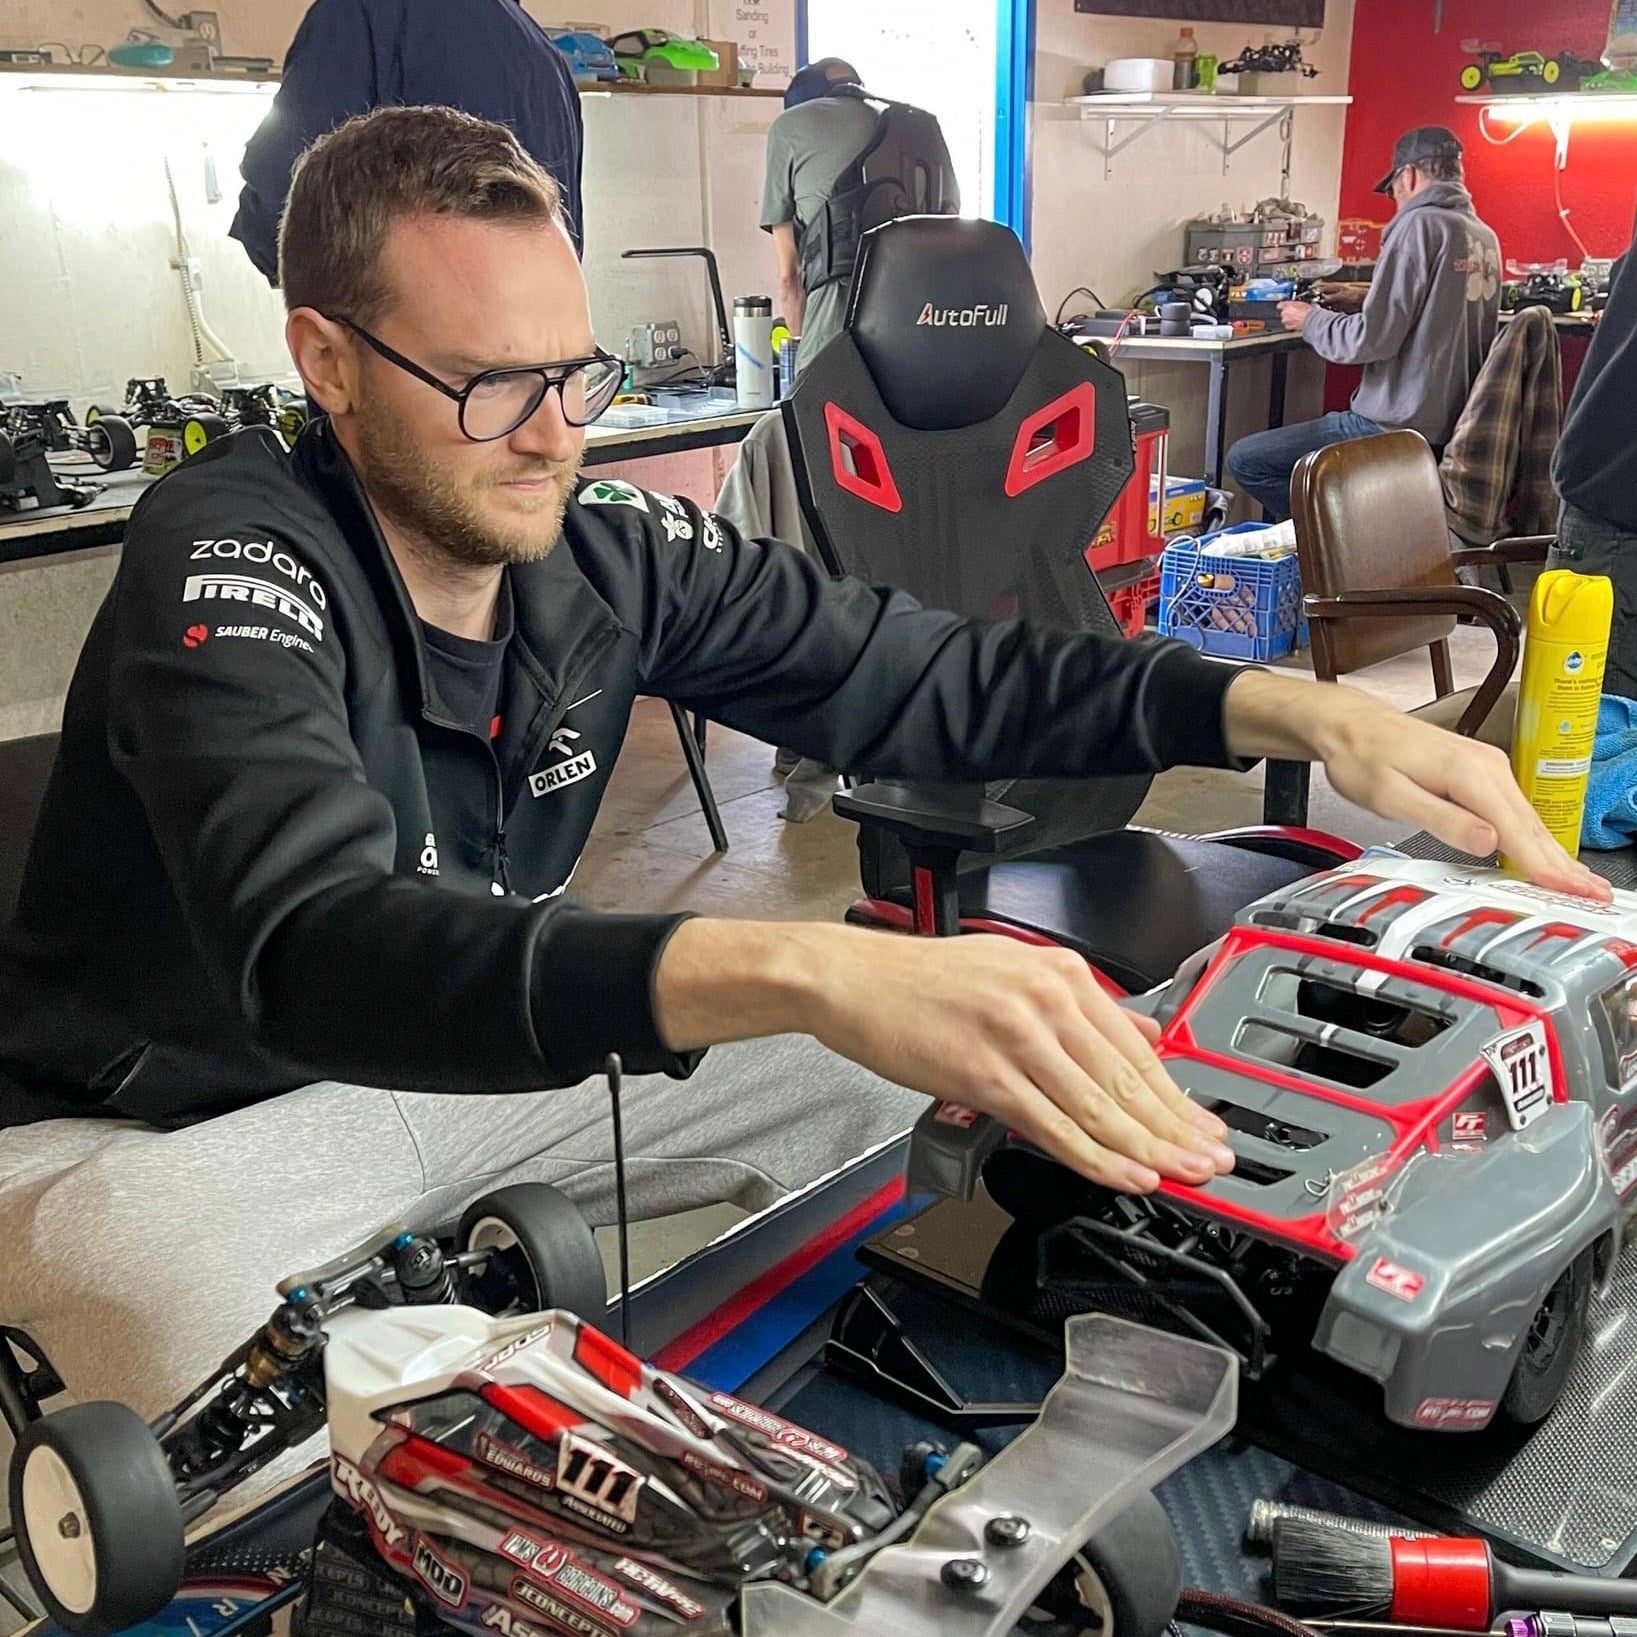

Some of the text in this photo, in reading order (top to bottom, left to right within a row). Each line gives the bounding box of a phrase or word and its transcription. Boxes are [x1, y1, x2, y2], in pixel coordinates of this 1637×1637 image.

[736, 8, 769, 25] Sanding
[759, 45, 779, 57] Tires
[916, 302, 1008, 326] AutoFull
[183, 573, 324, 642] PIRELLI
[215, 625, 269, 640] SAUBER
[533, 756, 592, 792] ORLEN
[1509, 1051, 1537, 1095] 111
[562, 1449, 637, 1506] 111
